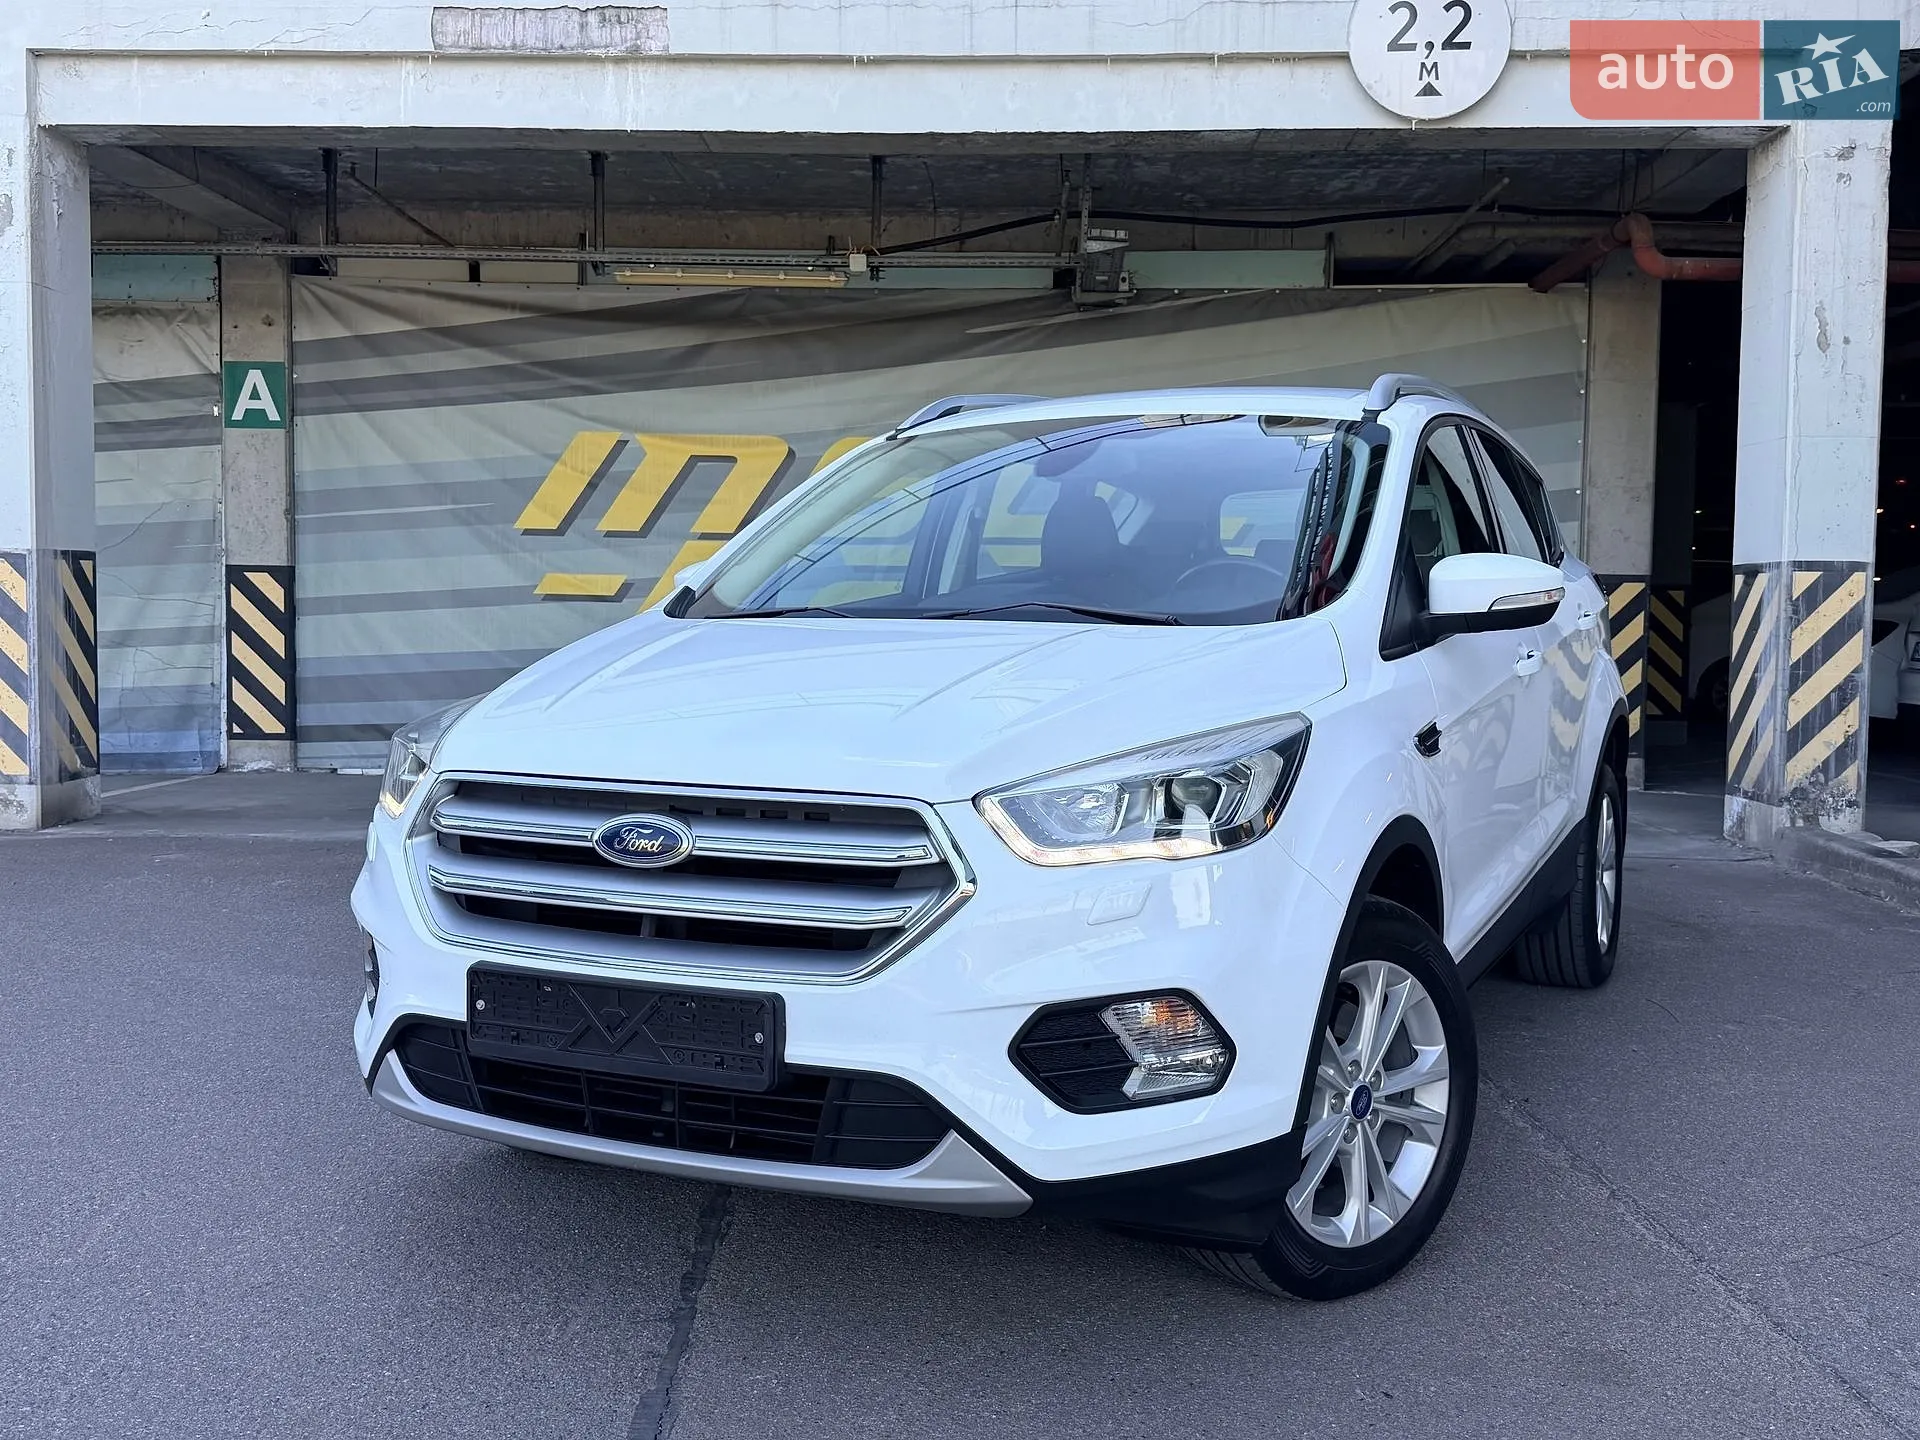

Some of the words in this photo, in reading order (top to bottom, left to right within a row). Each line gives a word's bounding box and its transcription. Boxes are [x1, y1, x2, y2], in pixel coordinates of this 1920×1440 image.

[1387, 0, 1472, 59] 2,2
[231, 369, 280, 421] A
[615, 826, 664, 853] Ford
